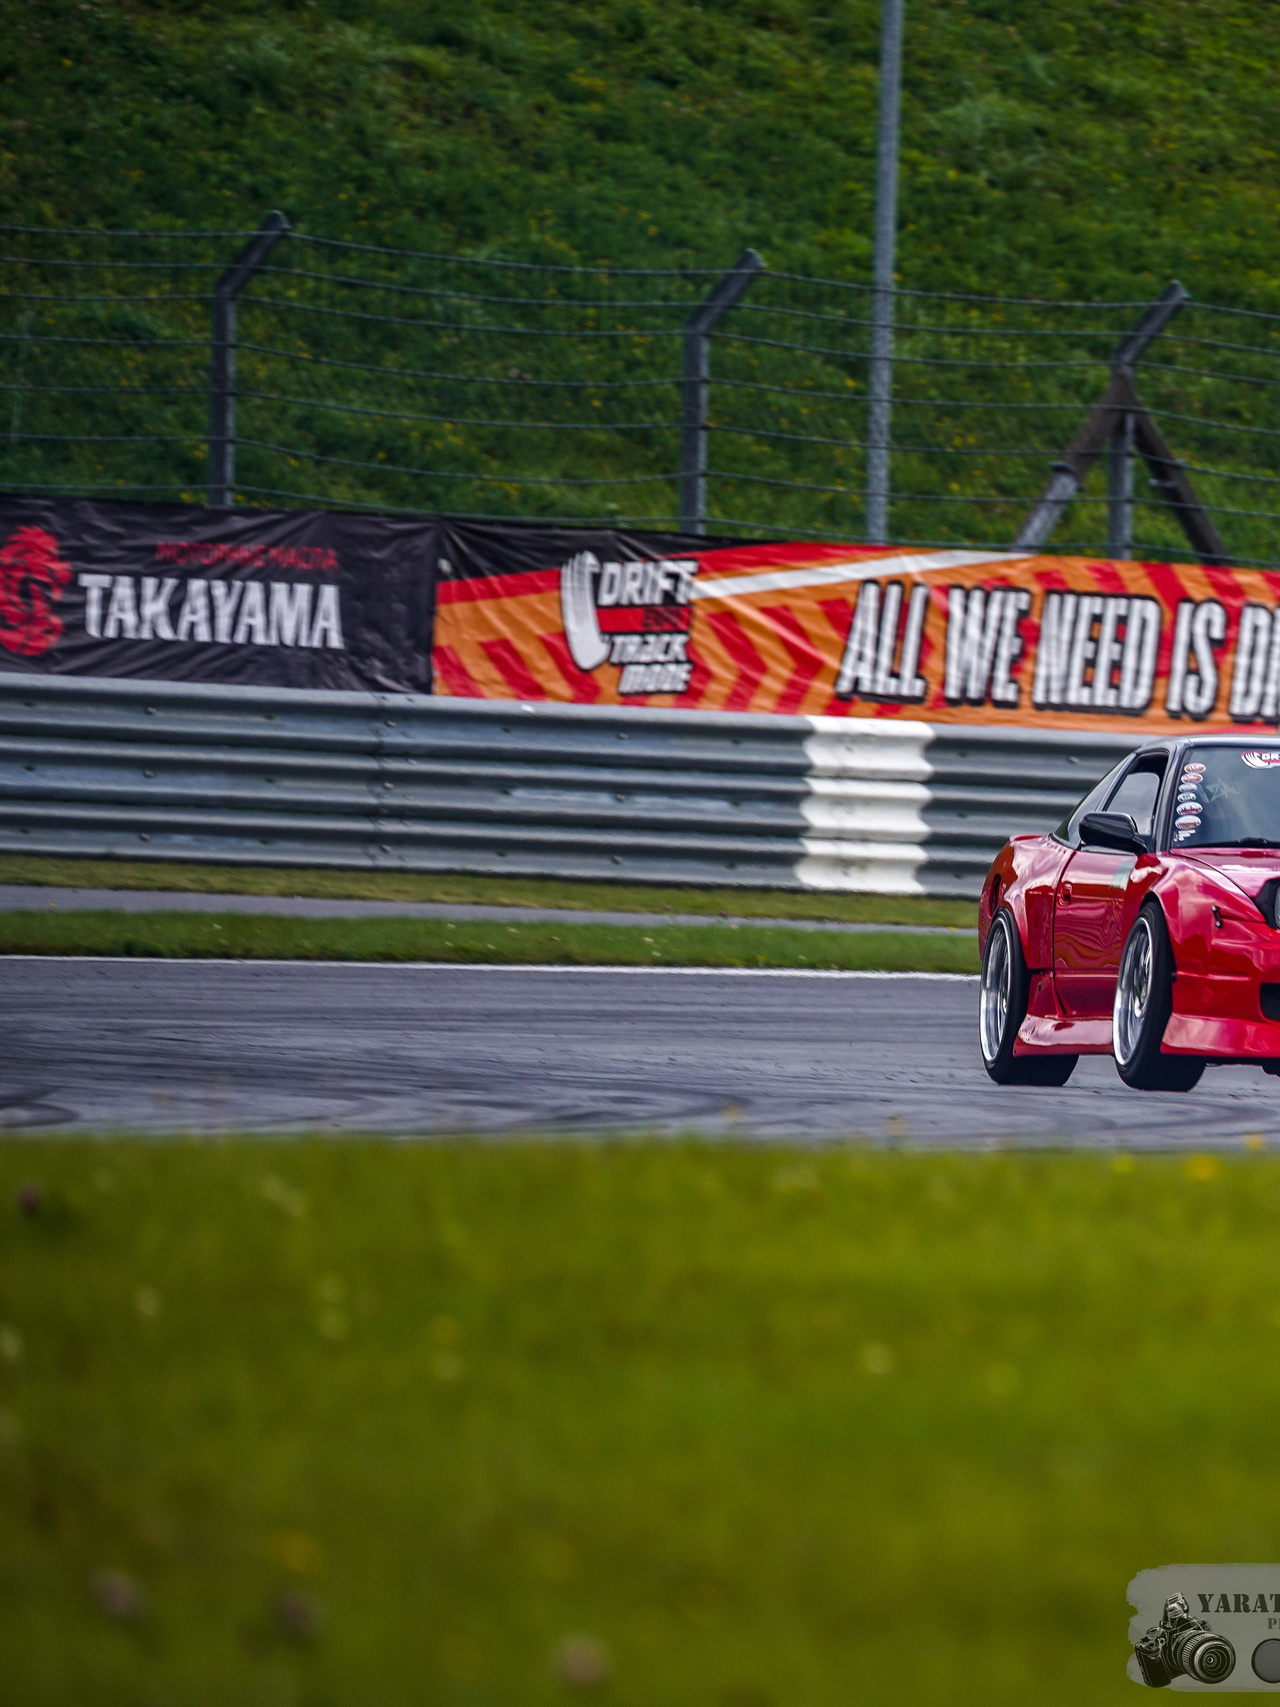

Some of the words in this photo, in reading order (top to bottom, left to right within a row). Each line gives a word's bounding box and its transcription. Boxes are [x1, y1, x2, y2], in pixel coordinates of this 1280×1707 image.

[78, 573, 345, 650] TAKAYAMA
[597, 560, 699, 606] DRIFT
[836, 580, 929, 704] ALL
[943, 584, 1031, 708] WE
[1033, 589, 1161, 715] NEED
[1166, 597, 1226, 720] IS
